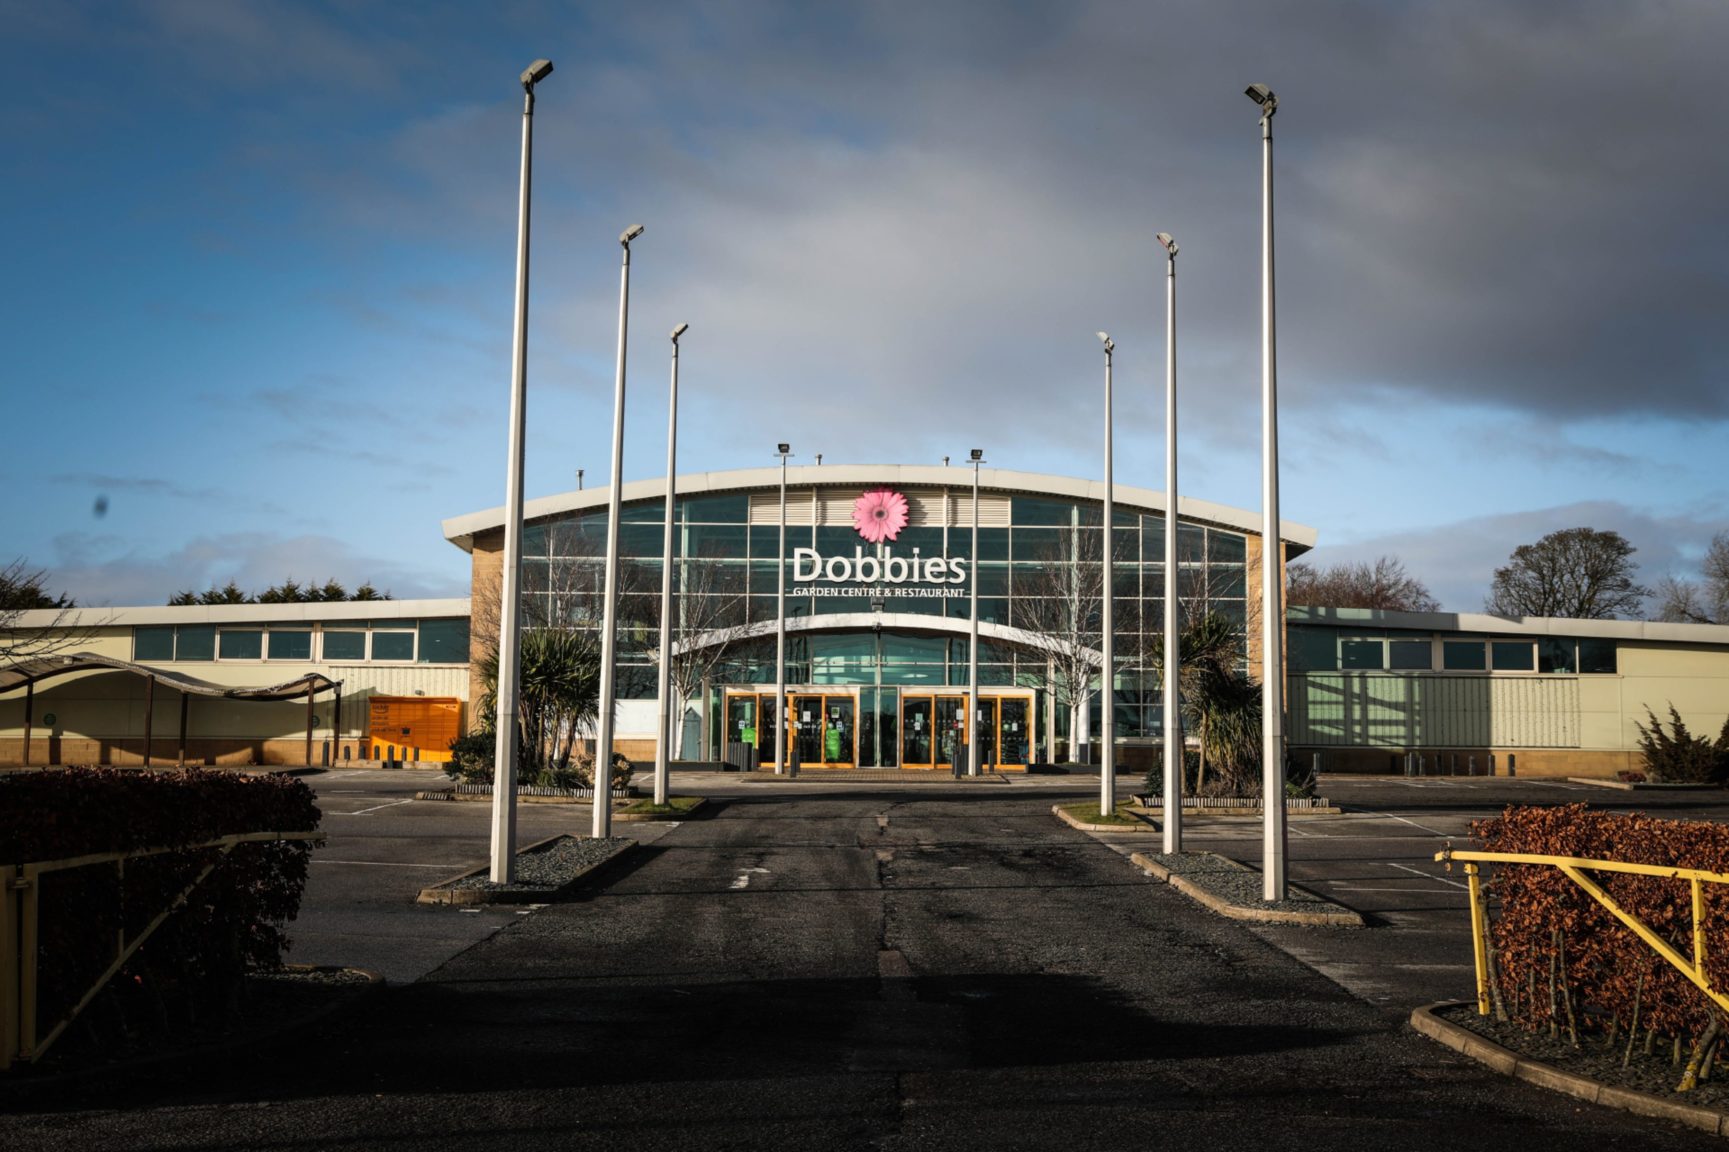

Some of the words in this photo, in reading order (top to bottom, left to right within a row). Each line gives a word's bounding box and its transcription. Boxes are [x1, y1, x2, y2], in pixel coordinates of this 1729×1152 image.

[793, 545, 966, 584] Dobbies
[793, 587, 838, 597] GARDEN
[841, 587, 882, 597] CENTRE
[884, 588, 892, 597] &
[895, 588, 965, 598] RESTAURANT
